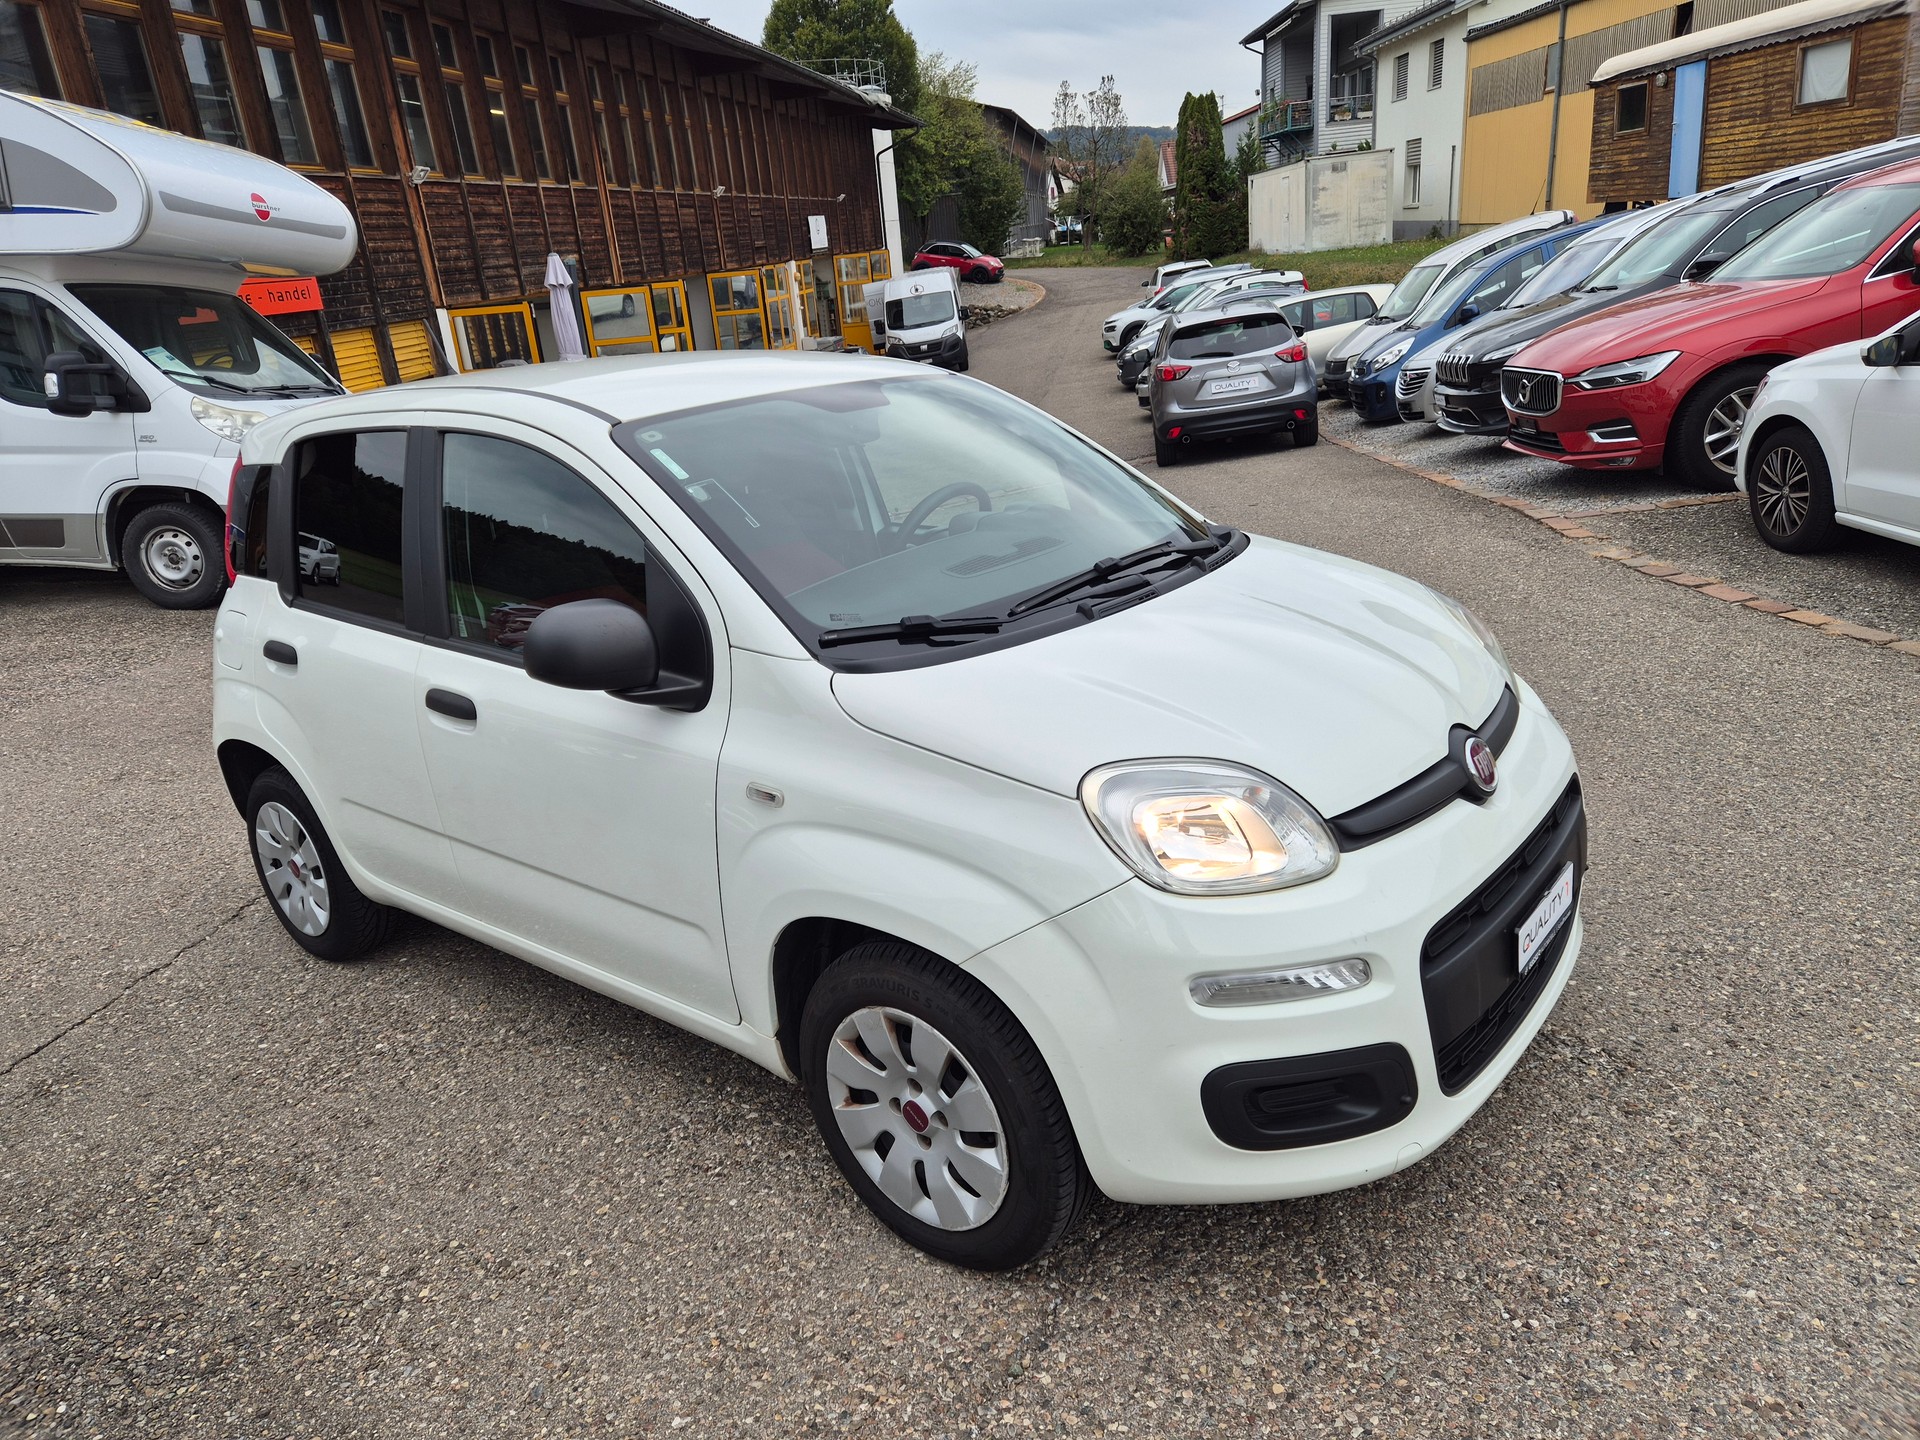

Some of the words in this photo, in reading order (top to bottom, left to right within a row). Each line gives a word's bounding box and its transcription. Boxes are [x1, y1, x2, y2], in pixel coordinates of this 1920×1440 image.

[251, 202, 281, 212] bürstner
[266, 285, 312, 303] handel
[1214, 380, 1252, 391] QUALITY
[1522, 886, 1565, 955] QUALITY
[1564, 881, 1570, 897] 1
